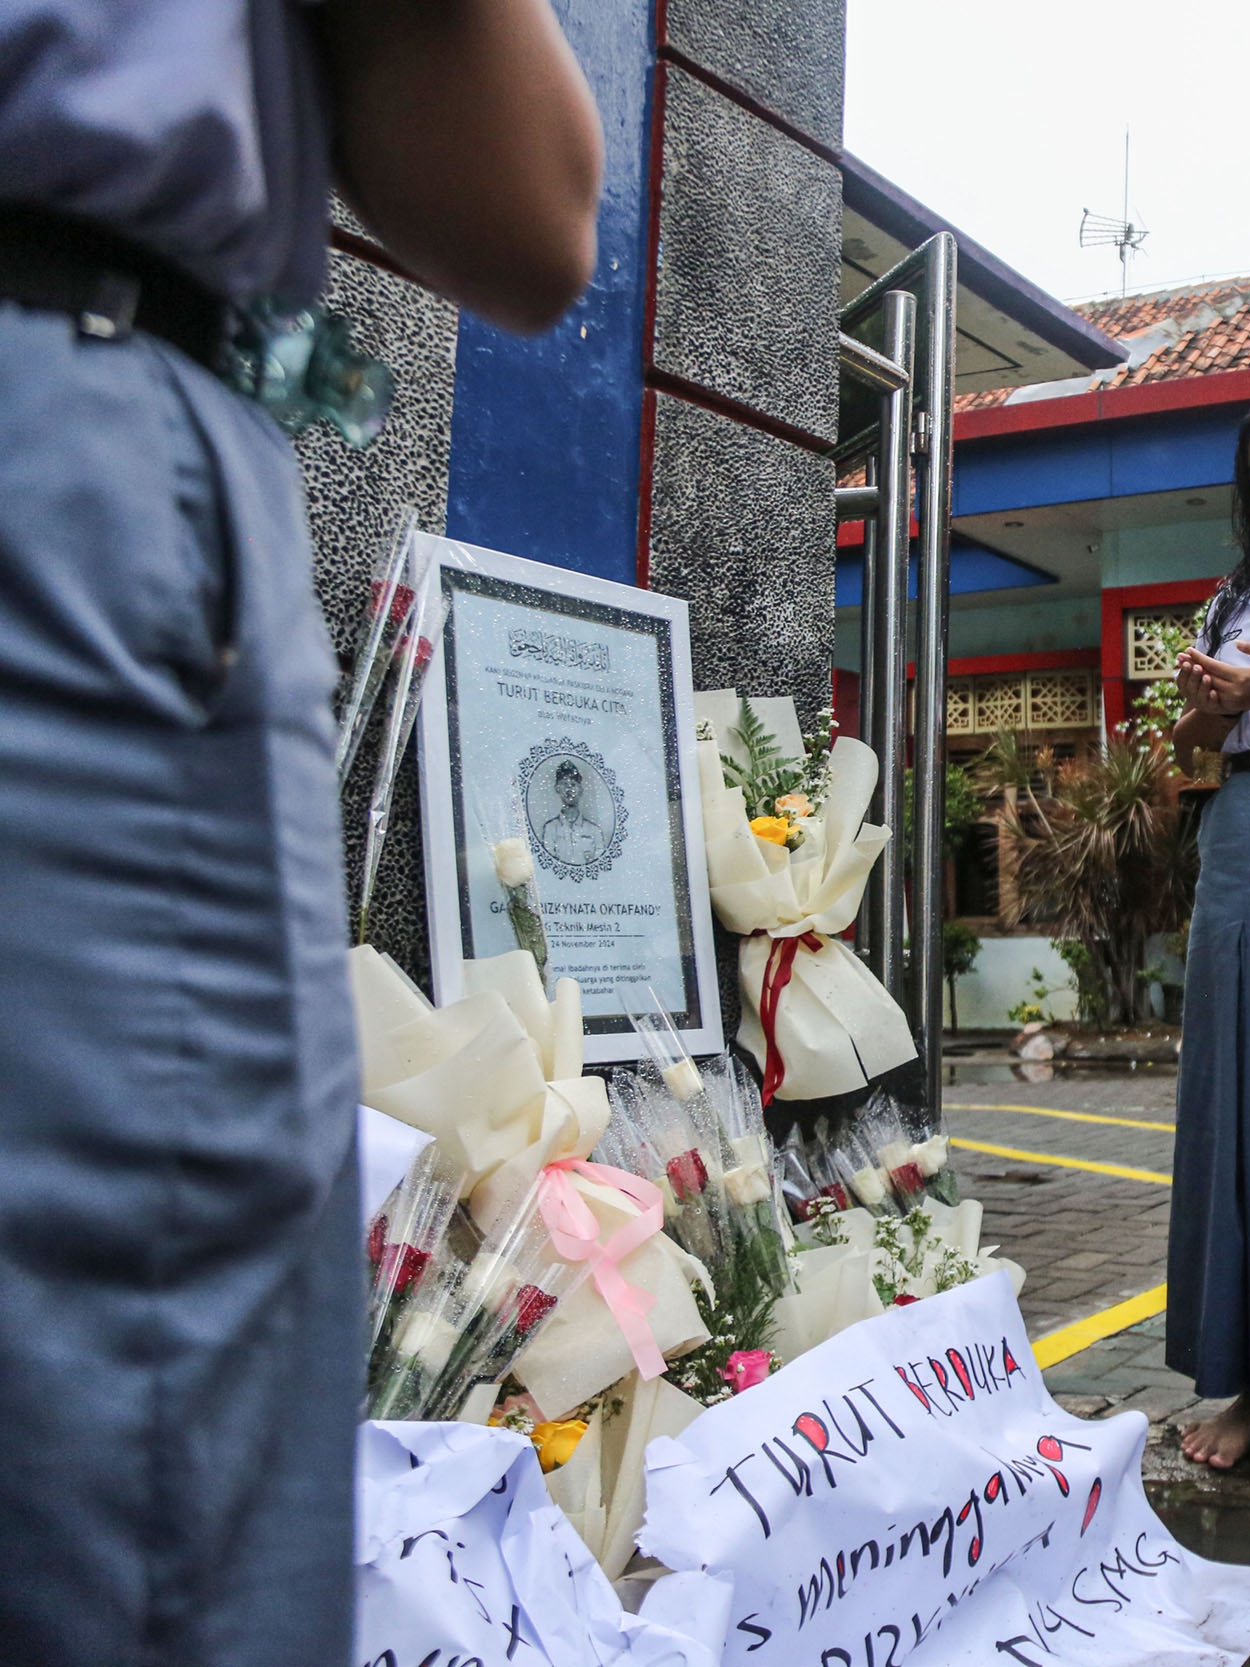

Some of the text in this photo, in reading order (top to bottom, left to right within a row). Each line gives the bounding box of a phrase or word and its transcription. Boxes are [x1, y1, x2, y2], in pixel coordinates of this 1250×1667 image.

[497, 682, 627, 716] TURUT BERDUKA CITA
[554, 921, 585, 933] Teknik
[615, 921, 621, 933] 2
[710, 1336, 1027, 1540] TURUT BERDUKA
